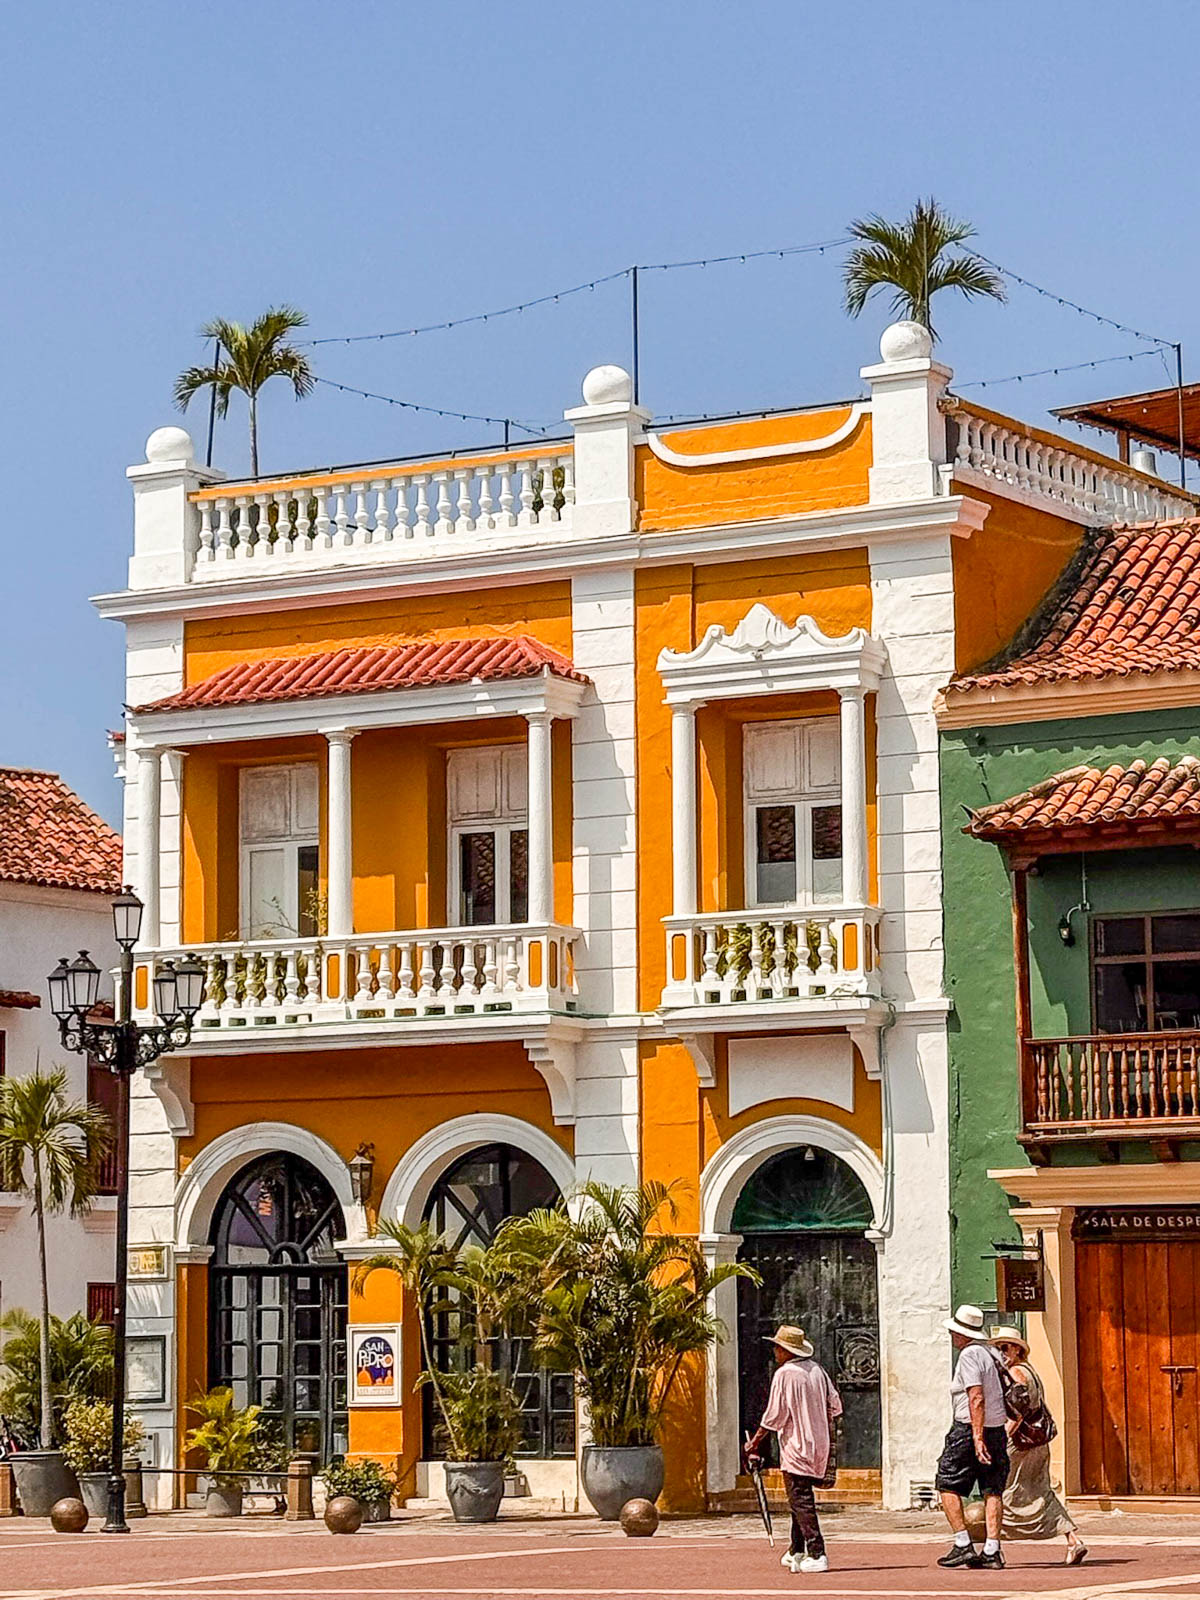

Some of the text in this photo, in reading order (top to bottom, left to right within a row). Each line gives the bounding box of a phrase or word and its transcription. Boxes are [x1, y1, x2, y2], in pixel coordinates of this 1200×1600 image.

[1091, 1216, 1129, 1227] SALA
[1133, 1216, 1152, 1227] DE
[365, 1341, 385, 1352] SAN
[358, 1349, 394, 1368] PEDRO
